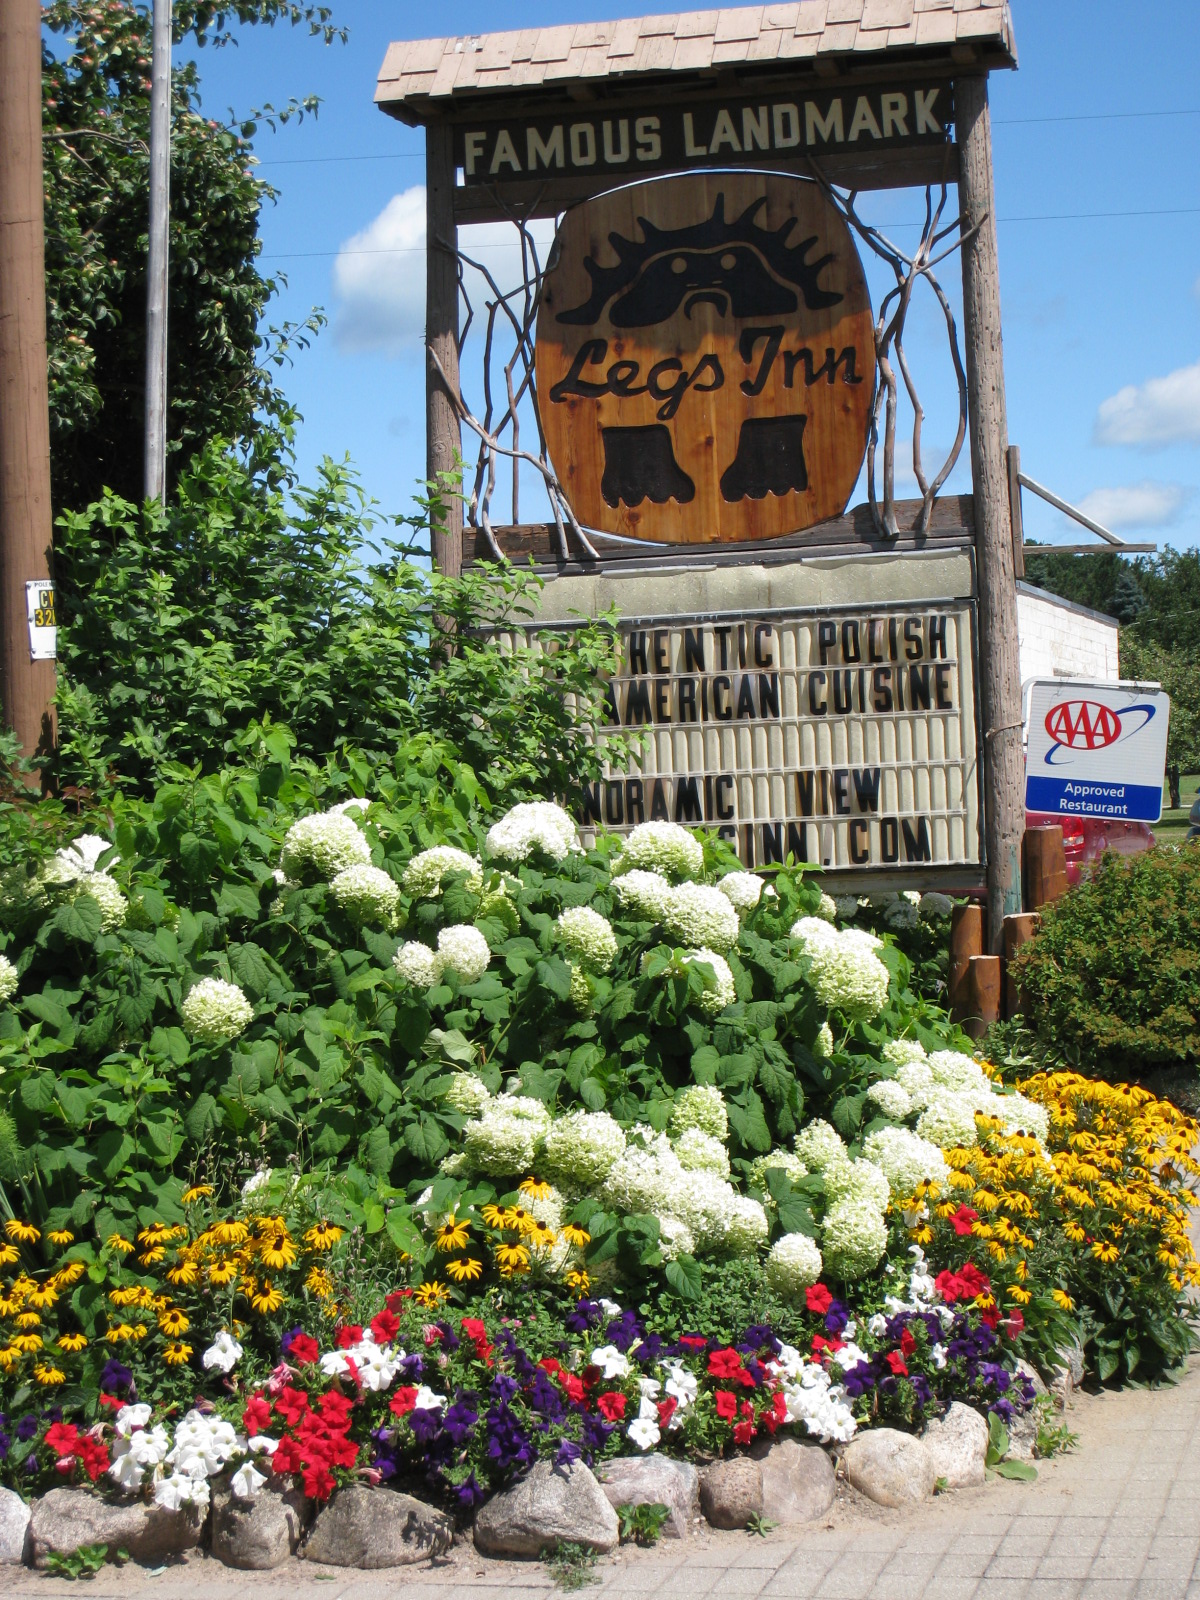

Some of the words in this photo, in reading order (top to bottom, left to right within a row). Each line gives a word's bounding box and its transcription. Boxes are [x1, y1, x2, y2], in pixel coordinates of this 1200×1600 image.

[464, 115, 662, 176] FAMOUS
[683, 88, 944, 158] LANDMARK
[549, 338, 725, 421] Legs
[739, 325, 862, 396] Inn
[818, 615, 947, 666] POLISH
[808, 664, 953, 716] CUISINE
[1053, 701, 1113, 749] AAA
[565, 774, 735, 826] NORAMIC
[796, 767, 881, 817] VIEW
[1059, 798, 1128, 815] Restaurant
[1064, 782, 1125, 798] Approved
